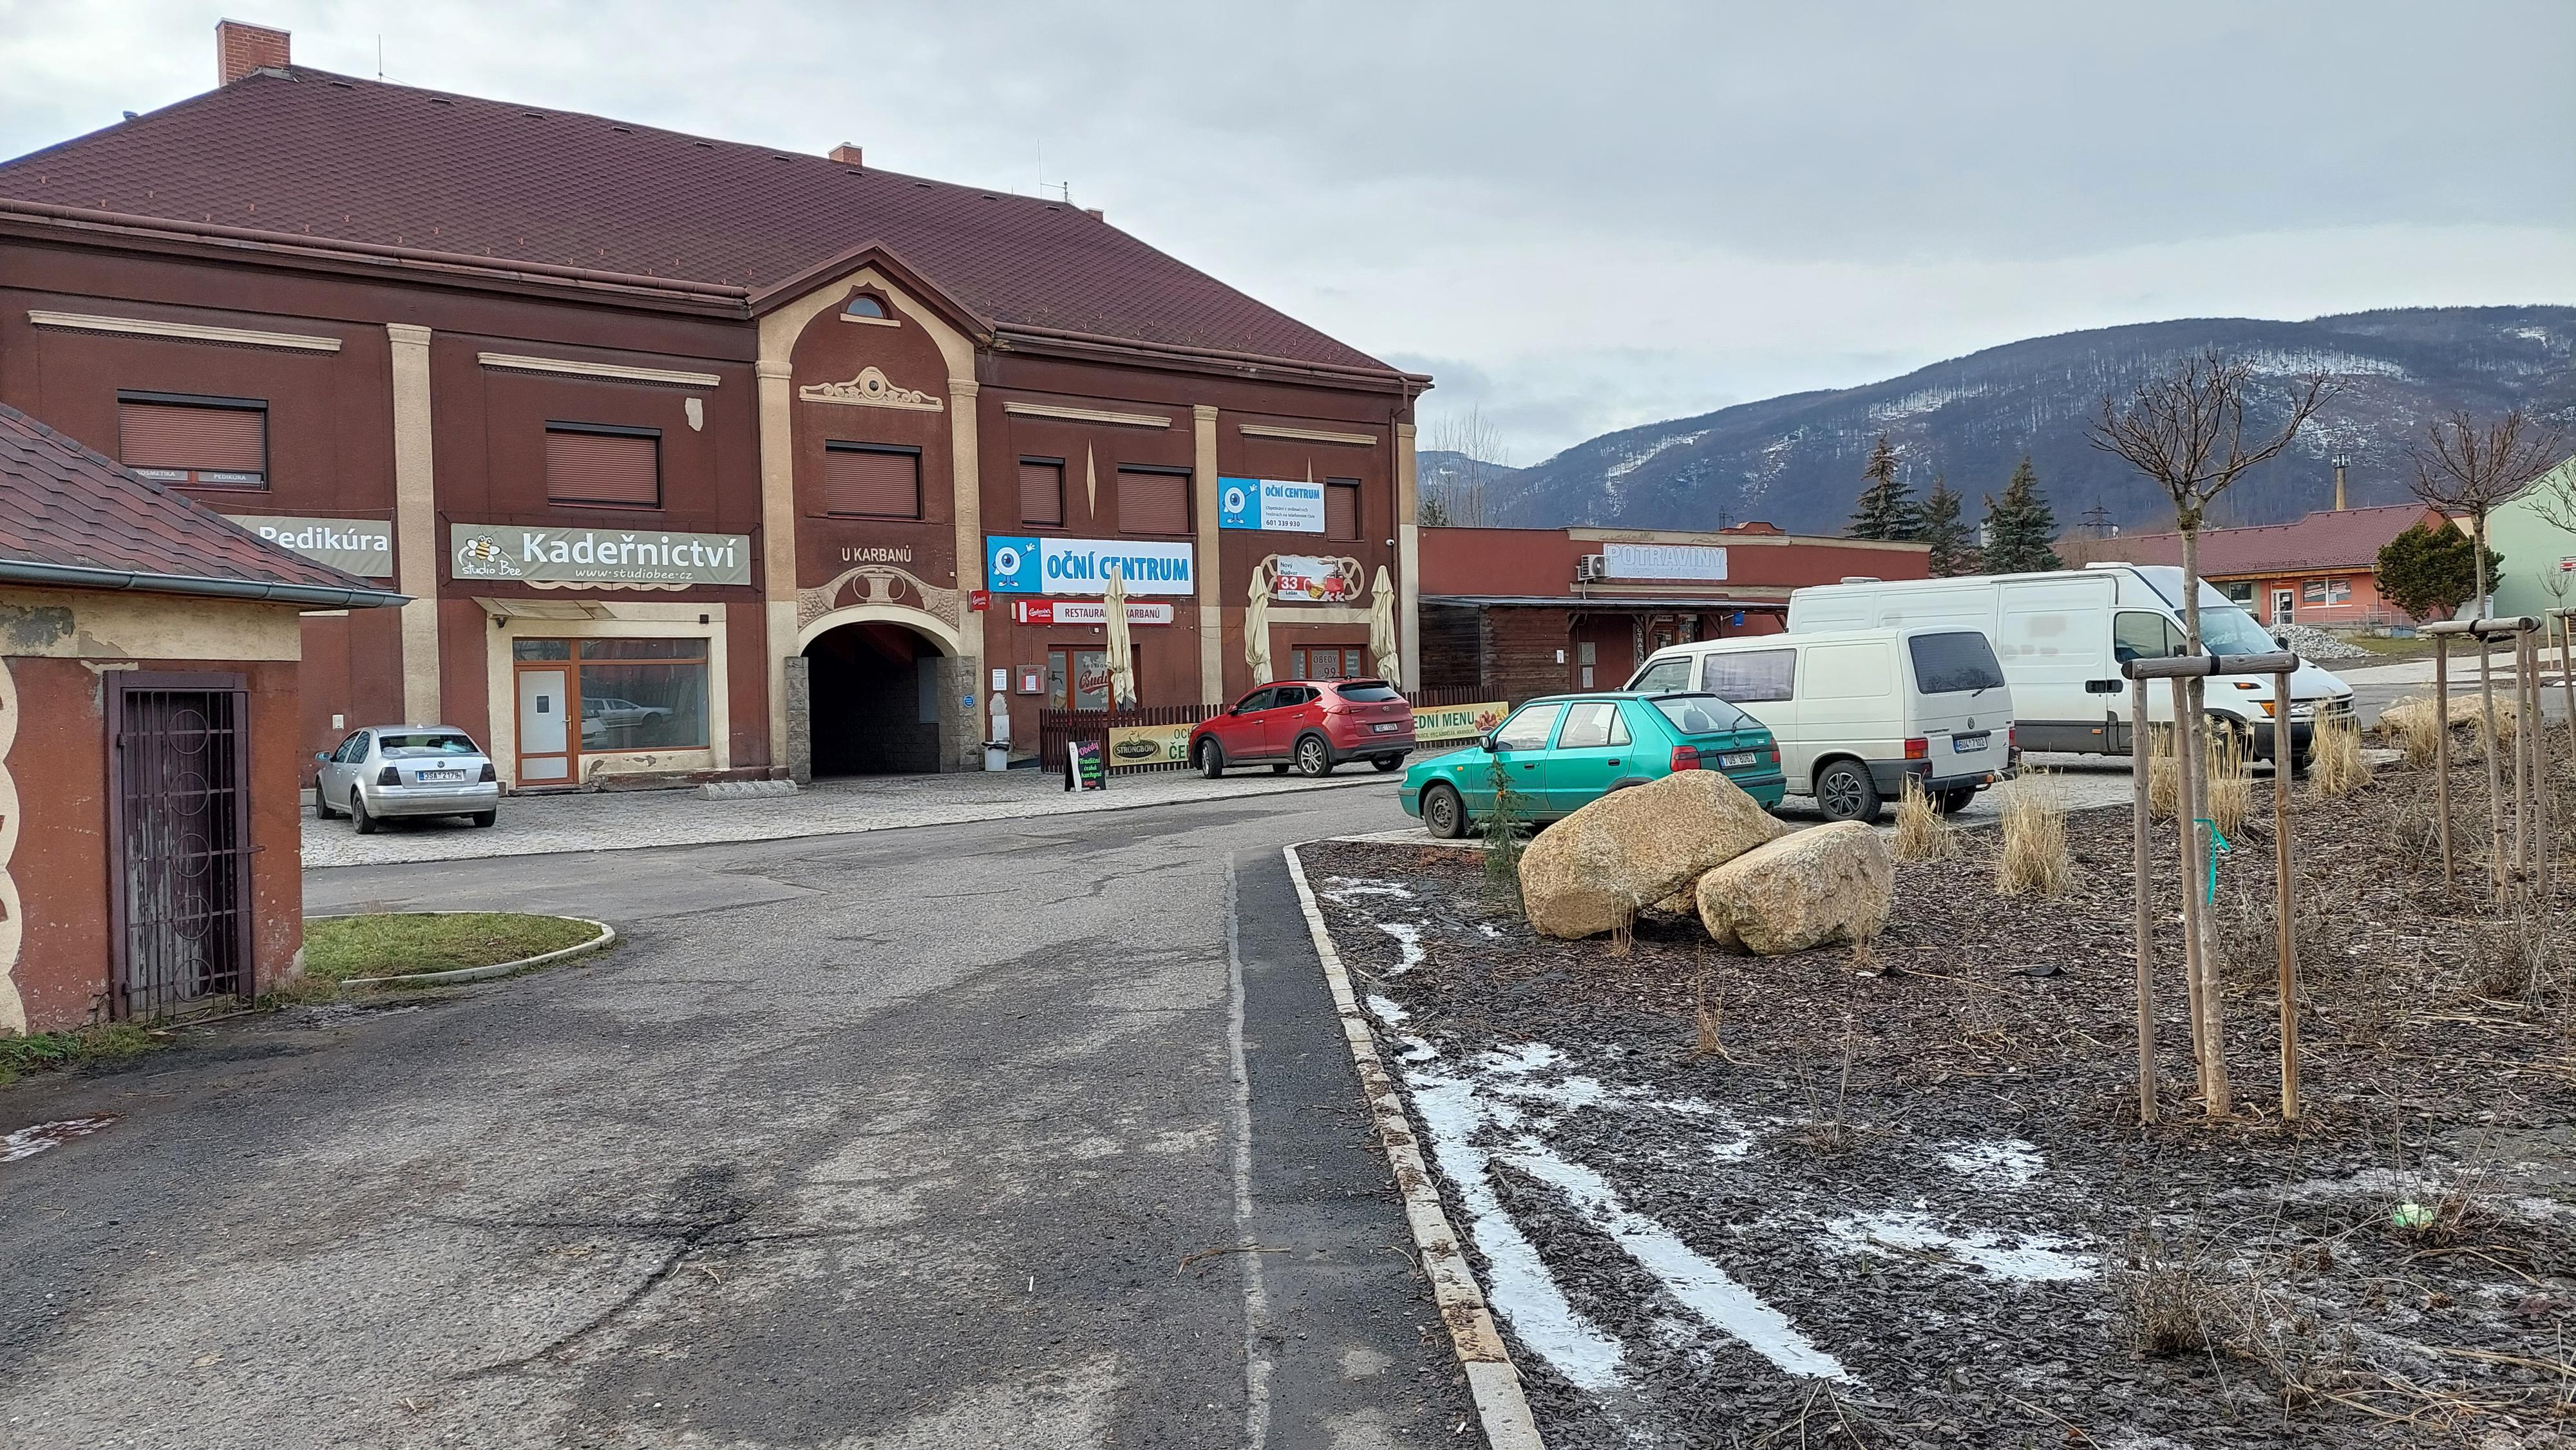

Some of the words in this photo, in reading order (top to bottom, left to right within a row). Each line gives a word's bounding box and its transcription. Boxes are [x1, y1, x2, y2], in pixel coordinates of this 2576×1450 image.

[1265, 484, 1283, 498] OČNÍ
[1285, 487, 1320, 500] CENTRUM
[259, 527, 388, 551] Pedikúra
[523, 532, 737, 568] Kadeřnictví
[842, 547, 850, 561] U
[854, 545, 911, 562] KARBANŮ
[1606, 545, 1724, 567] POTRAVINY
[461, 561, 496, 575] studio
[498, 559, 523, 576] Bee
[1046, 550, 1095, 579] OČNÍ
[575, 568, 694, 580] www.studiobee.cz
[1281, 576, 1298, 590] 33
[1065, 608, 1107, 618] RESTAURA
[1314, 652, 1337, 664] OBĚDY
[1414, 710, 1439, 730] EDNÍ
[1443, 711, 1475, 728] MENU
[1116, 744, 1155, 755] STRONGBOW
[1972, 738, 1985, 748] 7102
